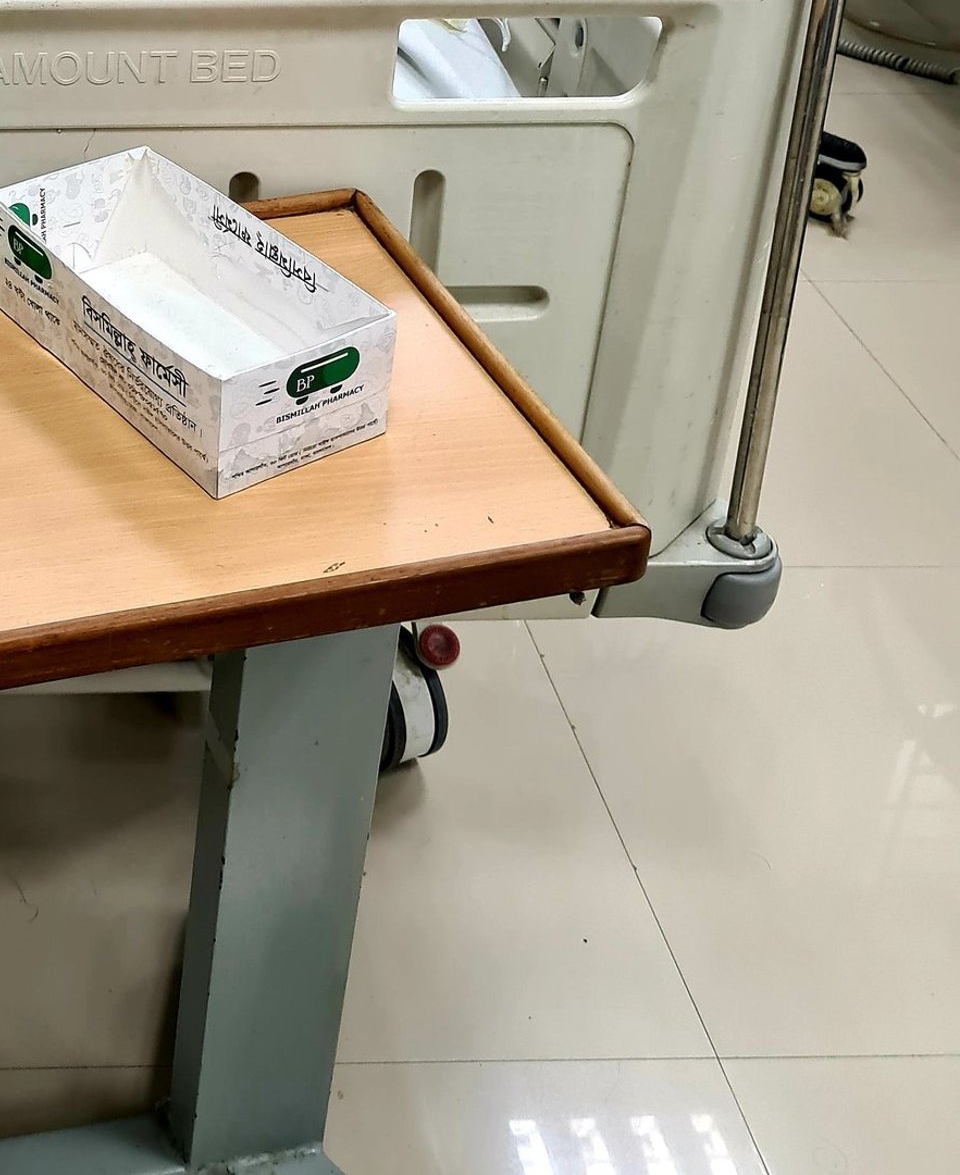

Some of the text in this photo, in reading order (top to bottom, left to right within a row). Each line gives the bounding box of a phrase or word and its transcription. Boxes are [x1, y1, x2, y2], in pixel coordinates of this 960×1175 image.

[189, 49, 283, 83] BED
[208, 204, 252, 247] ফার্মেসী
[139, 347, 190, 398] ফার্মেসী
[295, 374, 315, 393] BP
[276, 384, 365, 424] BISMILLAH PHARMACY
